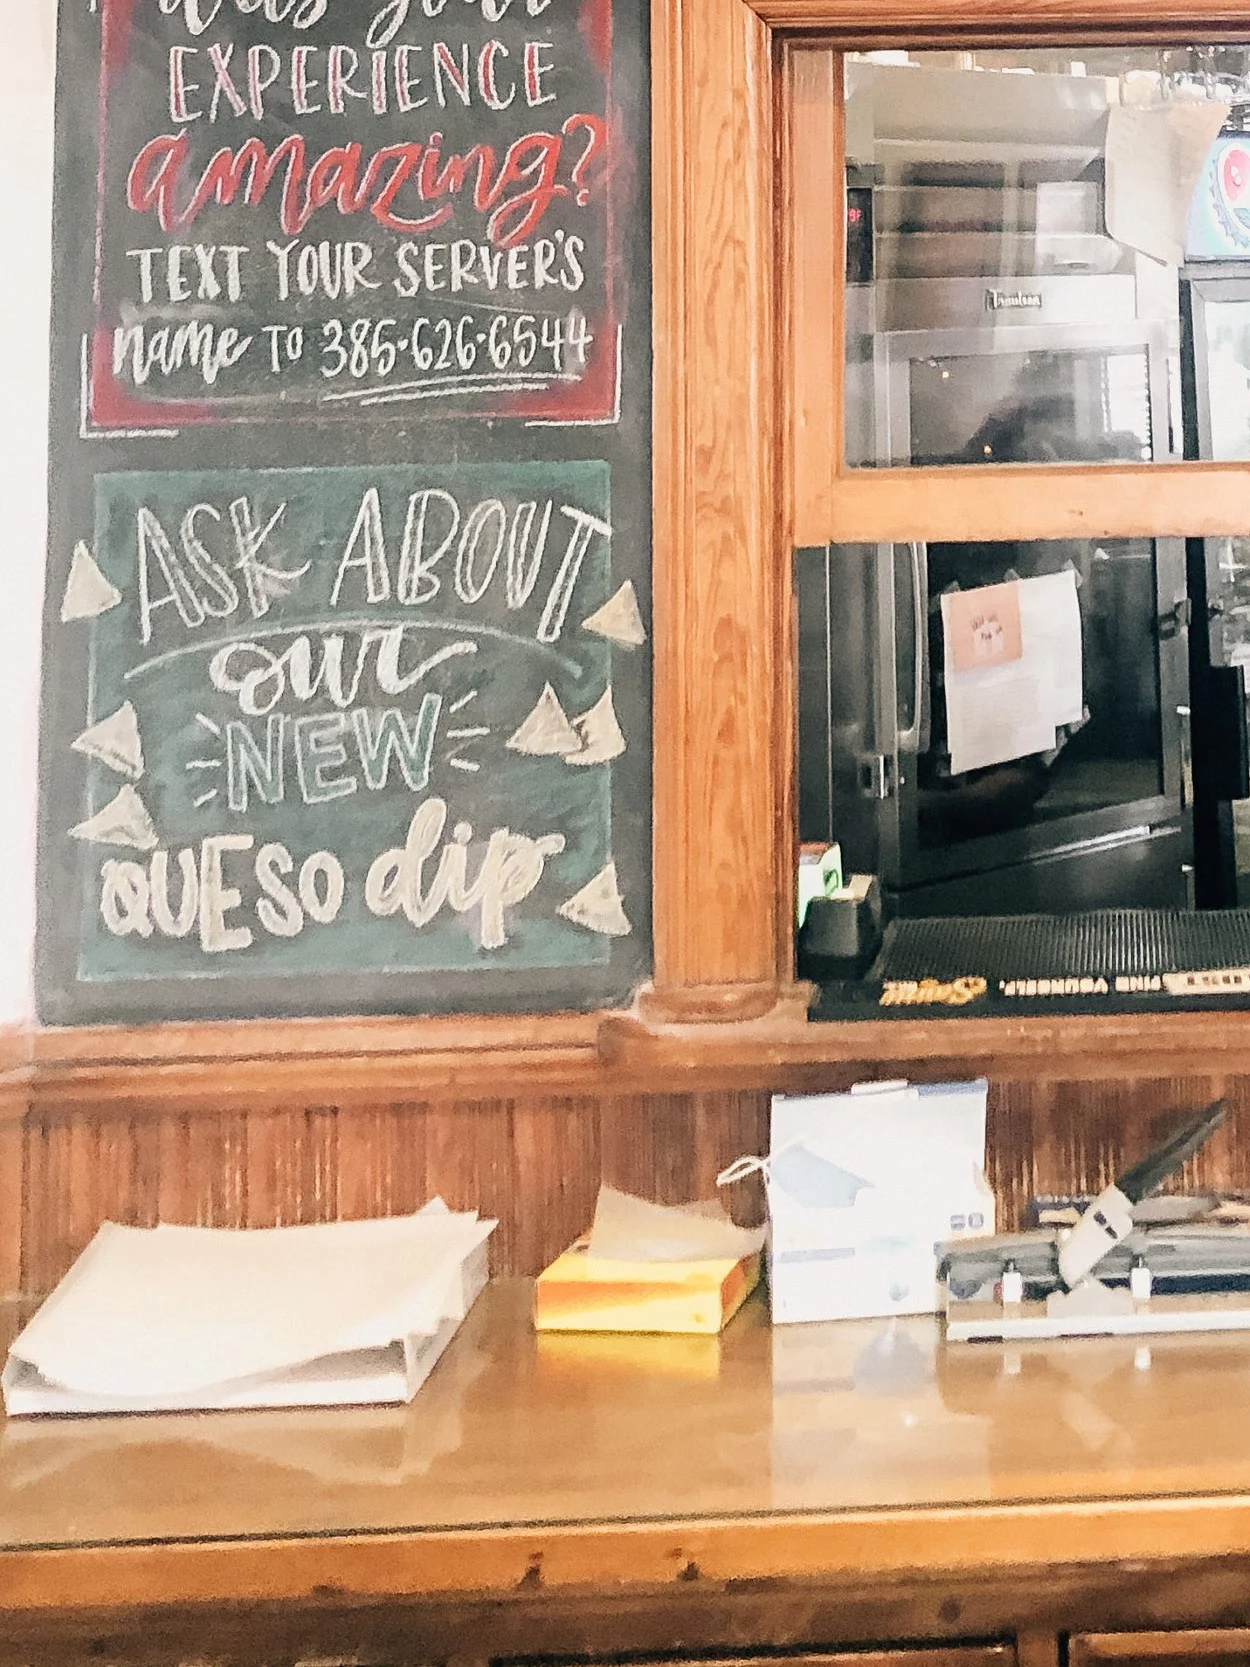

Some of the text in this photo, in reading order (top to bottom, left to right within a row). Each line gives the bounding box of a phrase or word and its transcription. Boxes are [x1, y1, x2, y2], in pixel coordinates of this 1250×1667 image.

[167, 40, 557, 124] EXPERIENCE
[127, 114, 607, 247] amazing?
[125, 229, 584, 303] TEXT YOUR SERVER'S
[113, 318, 254, 385] name
[262, 322, 302, 373] TO
[136, 487, 612, 644] ASK ABOUT
[210, 623, 478, 716] our
[226, 692, 443, 812] NEW
[100, 798, 566, 952] QUESO dip
